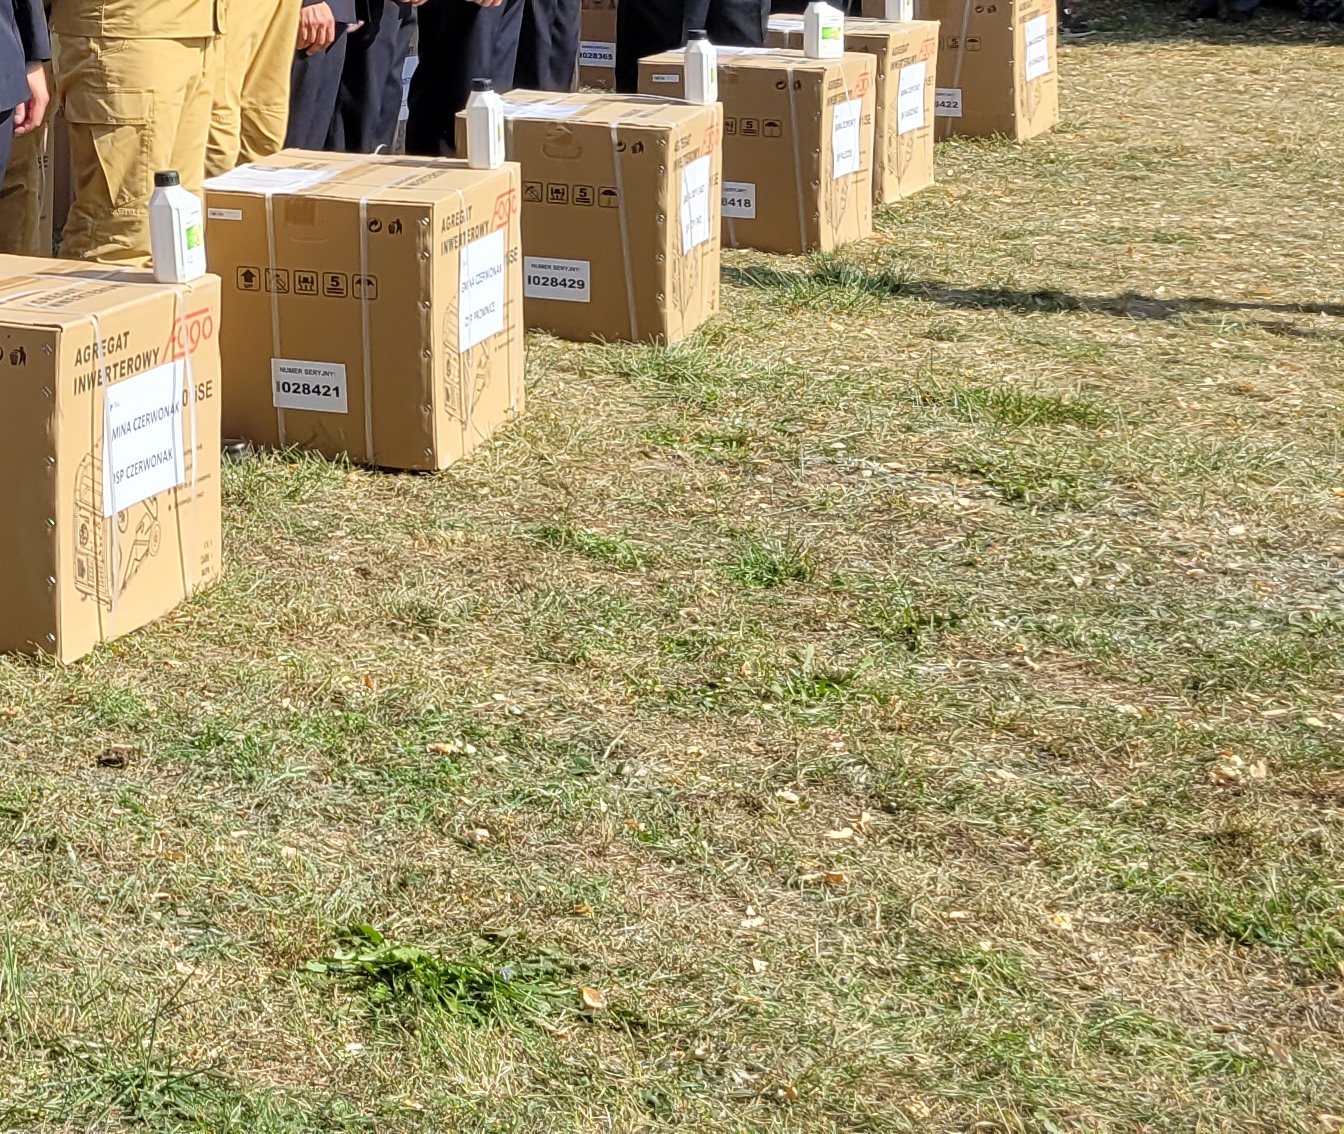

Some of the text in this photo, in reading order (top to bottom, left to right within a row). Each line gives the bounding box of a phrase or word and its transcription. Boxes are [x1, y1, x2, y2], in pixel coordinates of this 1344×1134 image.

[526, 274, 586, 290] I028429
[74, 330, 131, 368] AGREGAT
[275, 380, 341, 398] I028421
[110, 399, 180, 442] MINA CZERWONAK
[125, 448, 174, 481] CZERWONAK
